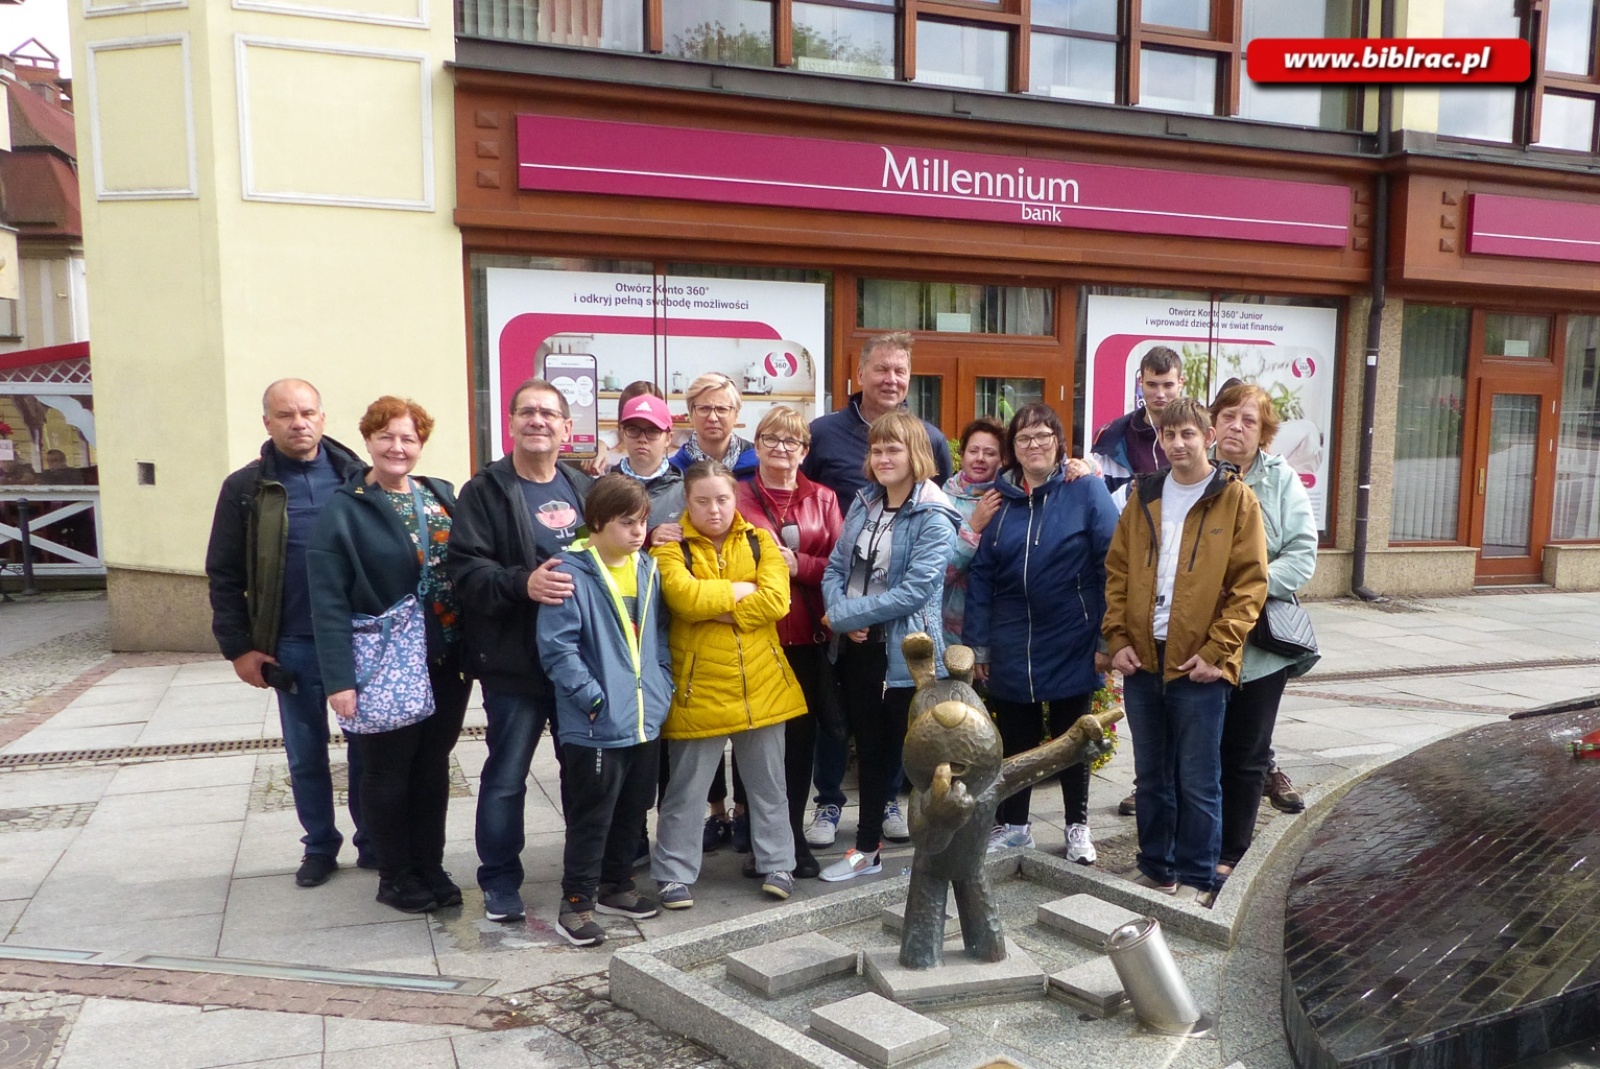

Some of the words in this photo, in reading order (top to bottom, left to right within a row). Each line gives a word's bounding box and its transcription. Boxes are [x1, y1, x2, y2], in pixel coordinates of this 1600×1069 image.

[881, 146, 1080, 203] Millennium
[1021, 203, 1062, 222] bank
[615, 282, 652, 294] Otwórz
[655, 284, 684, 295] Konto
[686, 286, 710, 296] 360°
[579, 294, 612, 307] odkryj
[614, 296, 644, 308] pełną
[646, 298, 691, 309] swobodę
[693, 298, 749, 310] możliwości
[1168, 307, 1196, 316] Otwórz
[1239, 312, 1263, 320] Junior
[1149, 318, 1189, 328] wprowadź
[1228, 321, 1249, 330] świat
[1250, 322, 1284, 332] finansów
